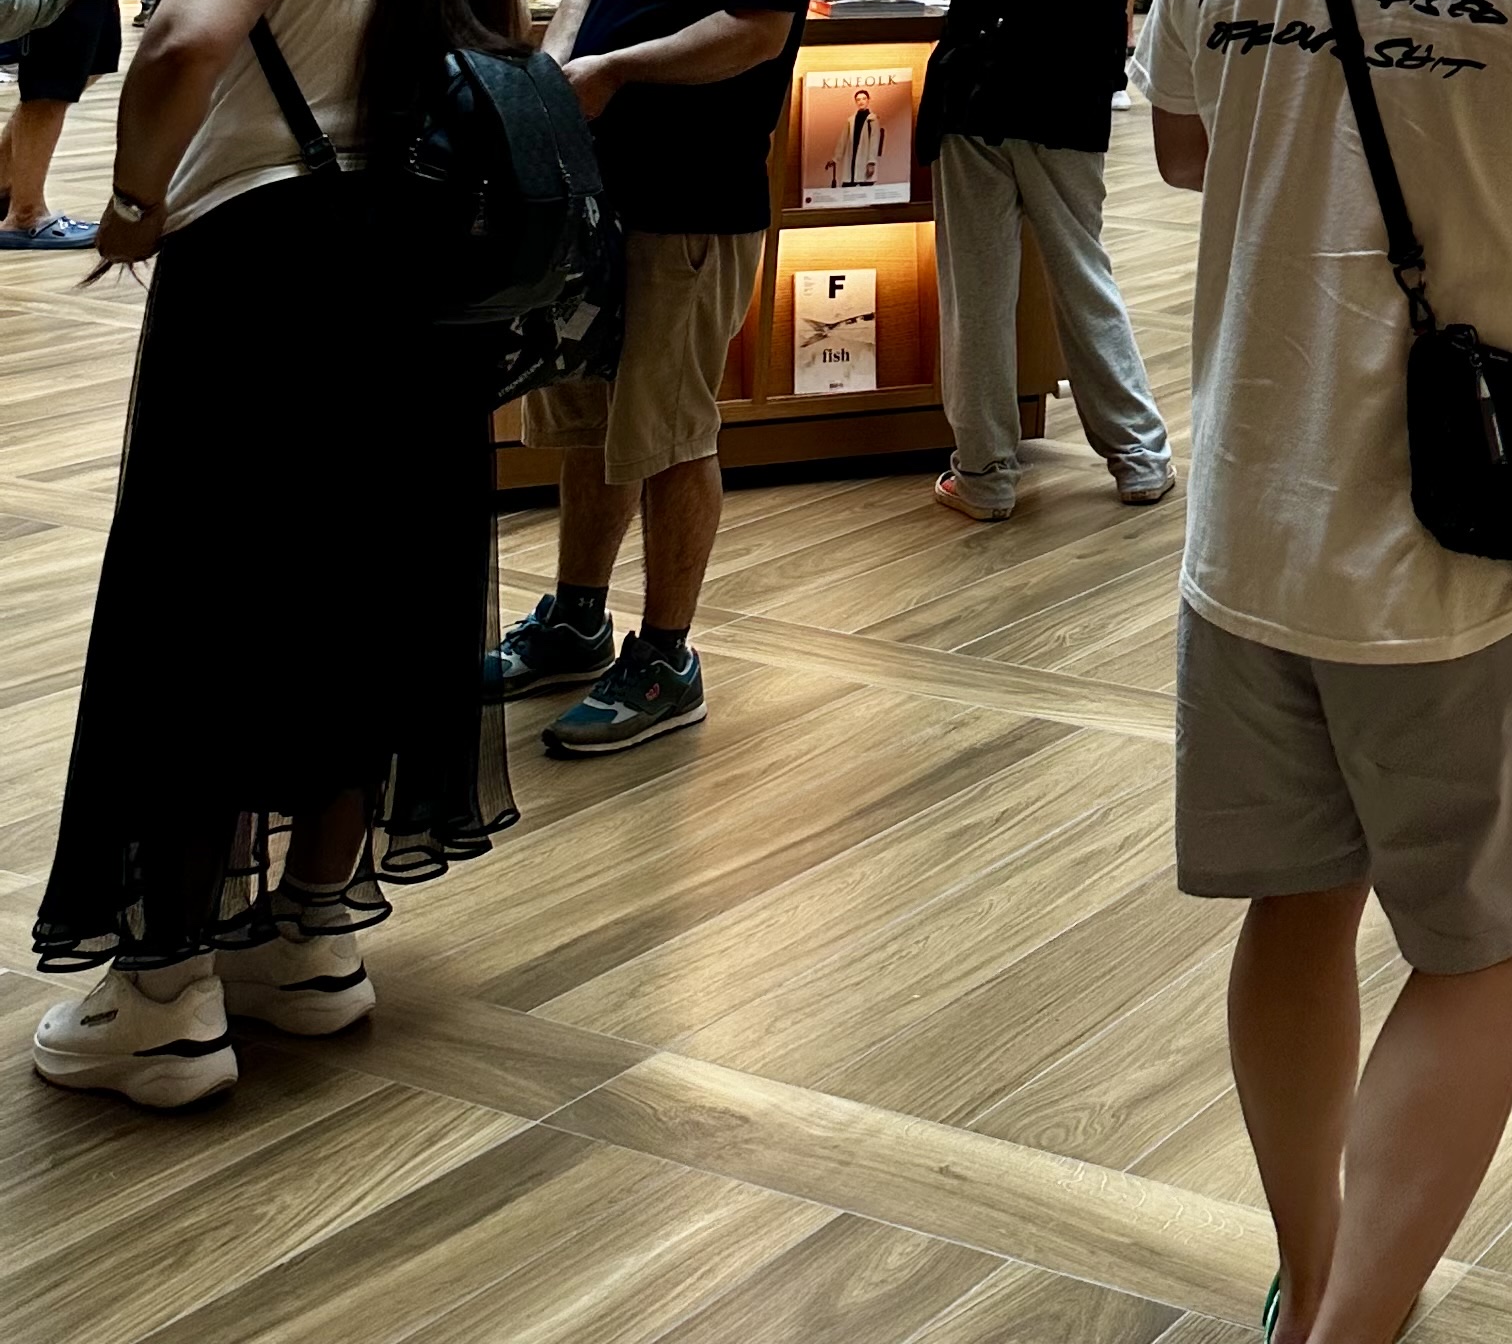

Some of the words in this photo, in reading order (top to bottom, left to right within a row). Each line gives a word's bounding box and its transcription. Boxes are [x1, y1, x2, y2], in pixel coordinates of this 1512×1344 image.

[821, 74, 898, 89] KINFOLK
[828, 275, 846, 299] F
[822, 347, 850, 363] fish
